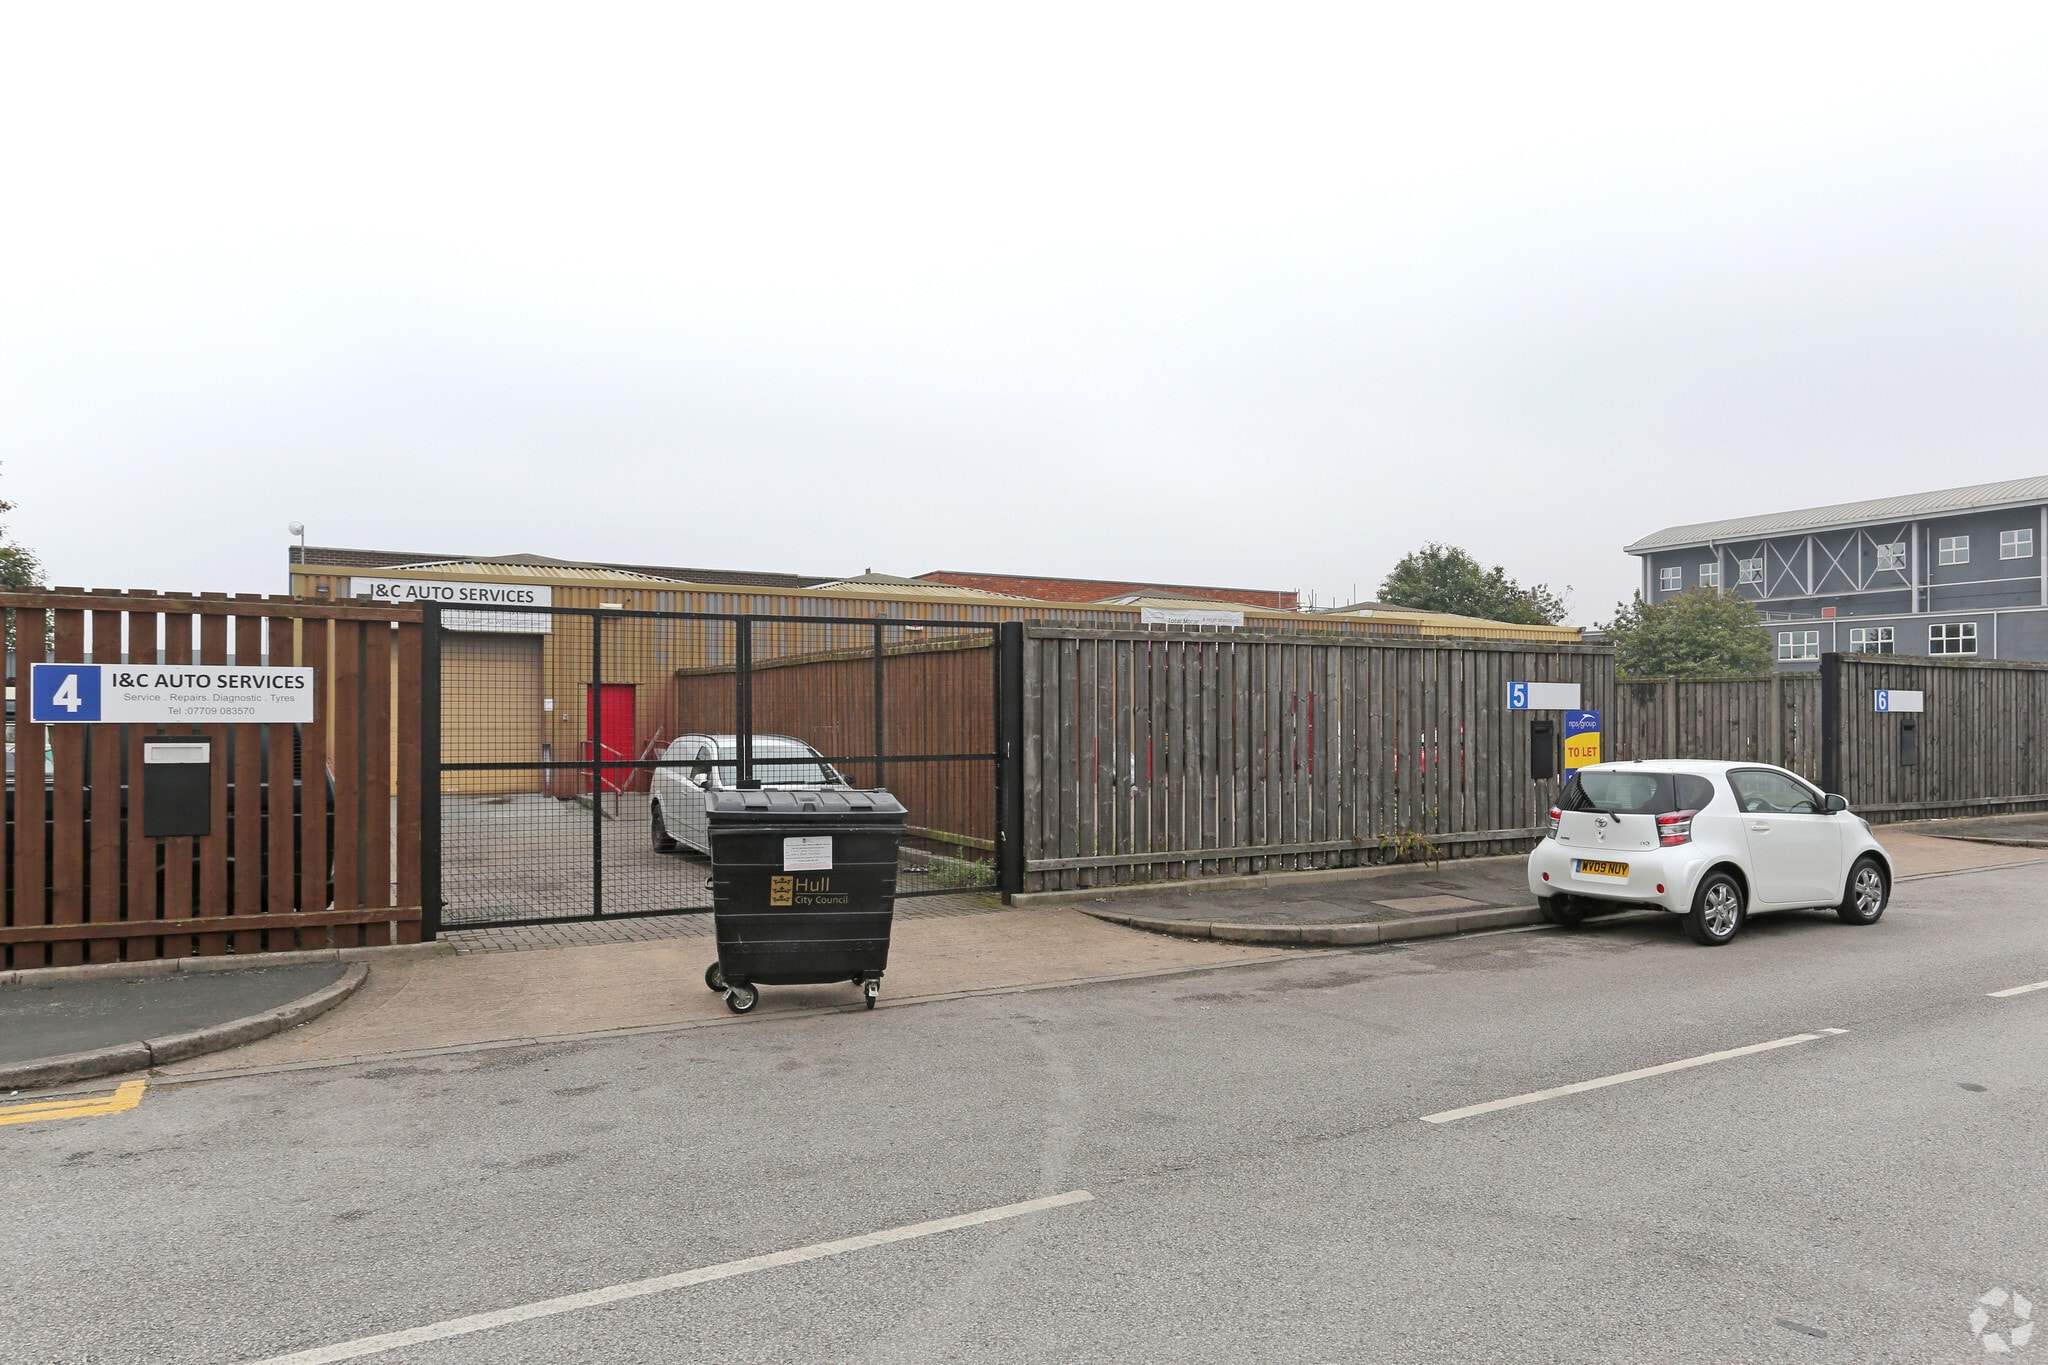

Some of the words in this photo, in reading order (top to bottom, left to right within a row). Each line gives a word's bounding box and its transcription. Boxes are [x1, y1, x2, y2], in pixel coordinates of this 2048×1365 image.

[406, 585, 454, 600] AUTO
[459, 587, 534, 603] SERVICES
[112, 673, 149, 688] I&C
[154, 673, 211, 689] AUTO
[217, 674, 305, 690] SERVICES
[52, 674, 82, 713] 4
[123, 693, 161, 702] Service
[213, 693, 262, 704] Diagnostic
[270, 694, 295, 704] Tyres
[1513, 683, 1525, 707] 5
[1879, 691, 1886, 710] 6
[219, 706, 255, 715] 083570
[1568, 747, 1580, 757] TO
[1582, 746, 1597, 757] LET
[1582, 860, 1606, 873] WV09
[1608, 863, 1628, 875] NUY
[796, 877, 830, 892] Hull
[795, 896, 813, 906] City
[815, 895, 849, 904] Council
